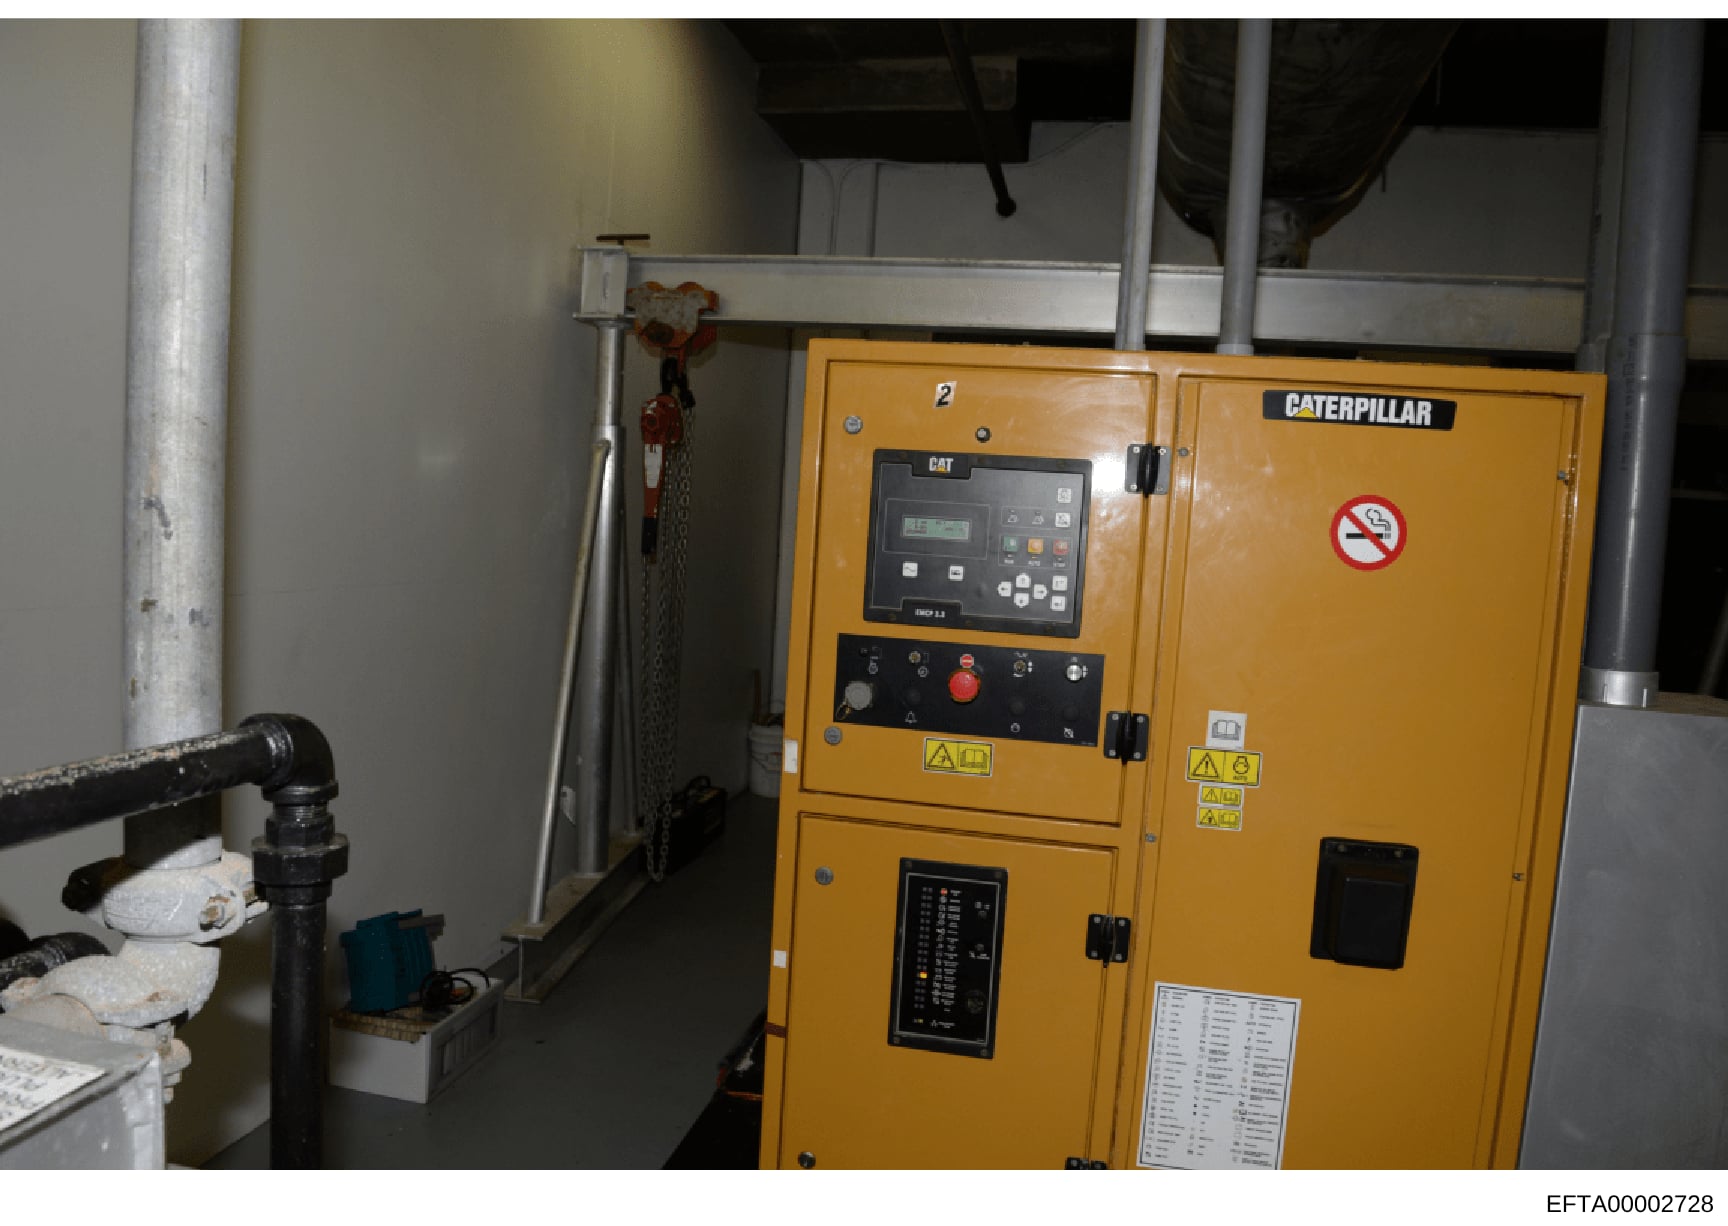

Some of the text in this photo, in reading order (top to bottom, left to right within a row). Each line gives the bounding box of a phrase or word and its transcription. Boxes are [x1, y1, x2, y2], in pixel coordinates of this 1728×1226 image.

[936, 385, 951, 407] 2
[1286, 392, 1432, 426] CATERPILLAR
[929, 456, 954, 473] CAT
